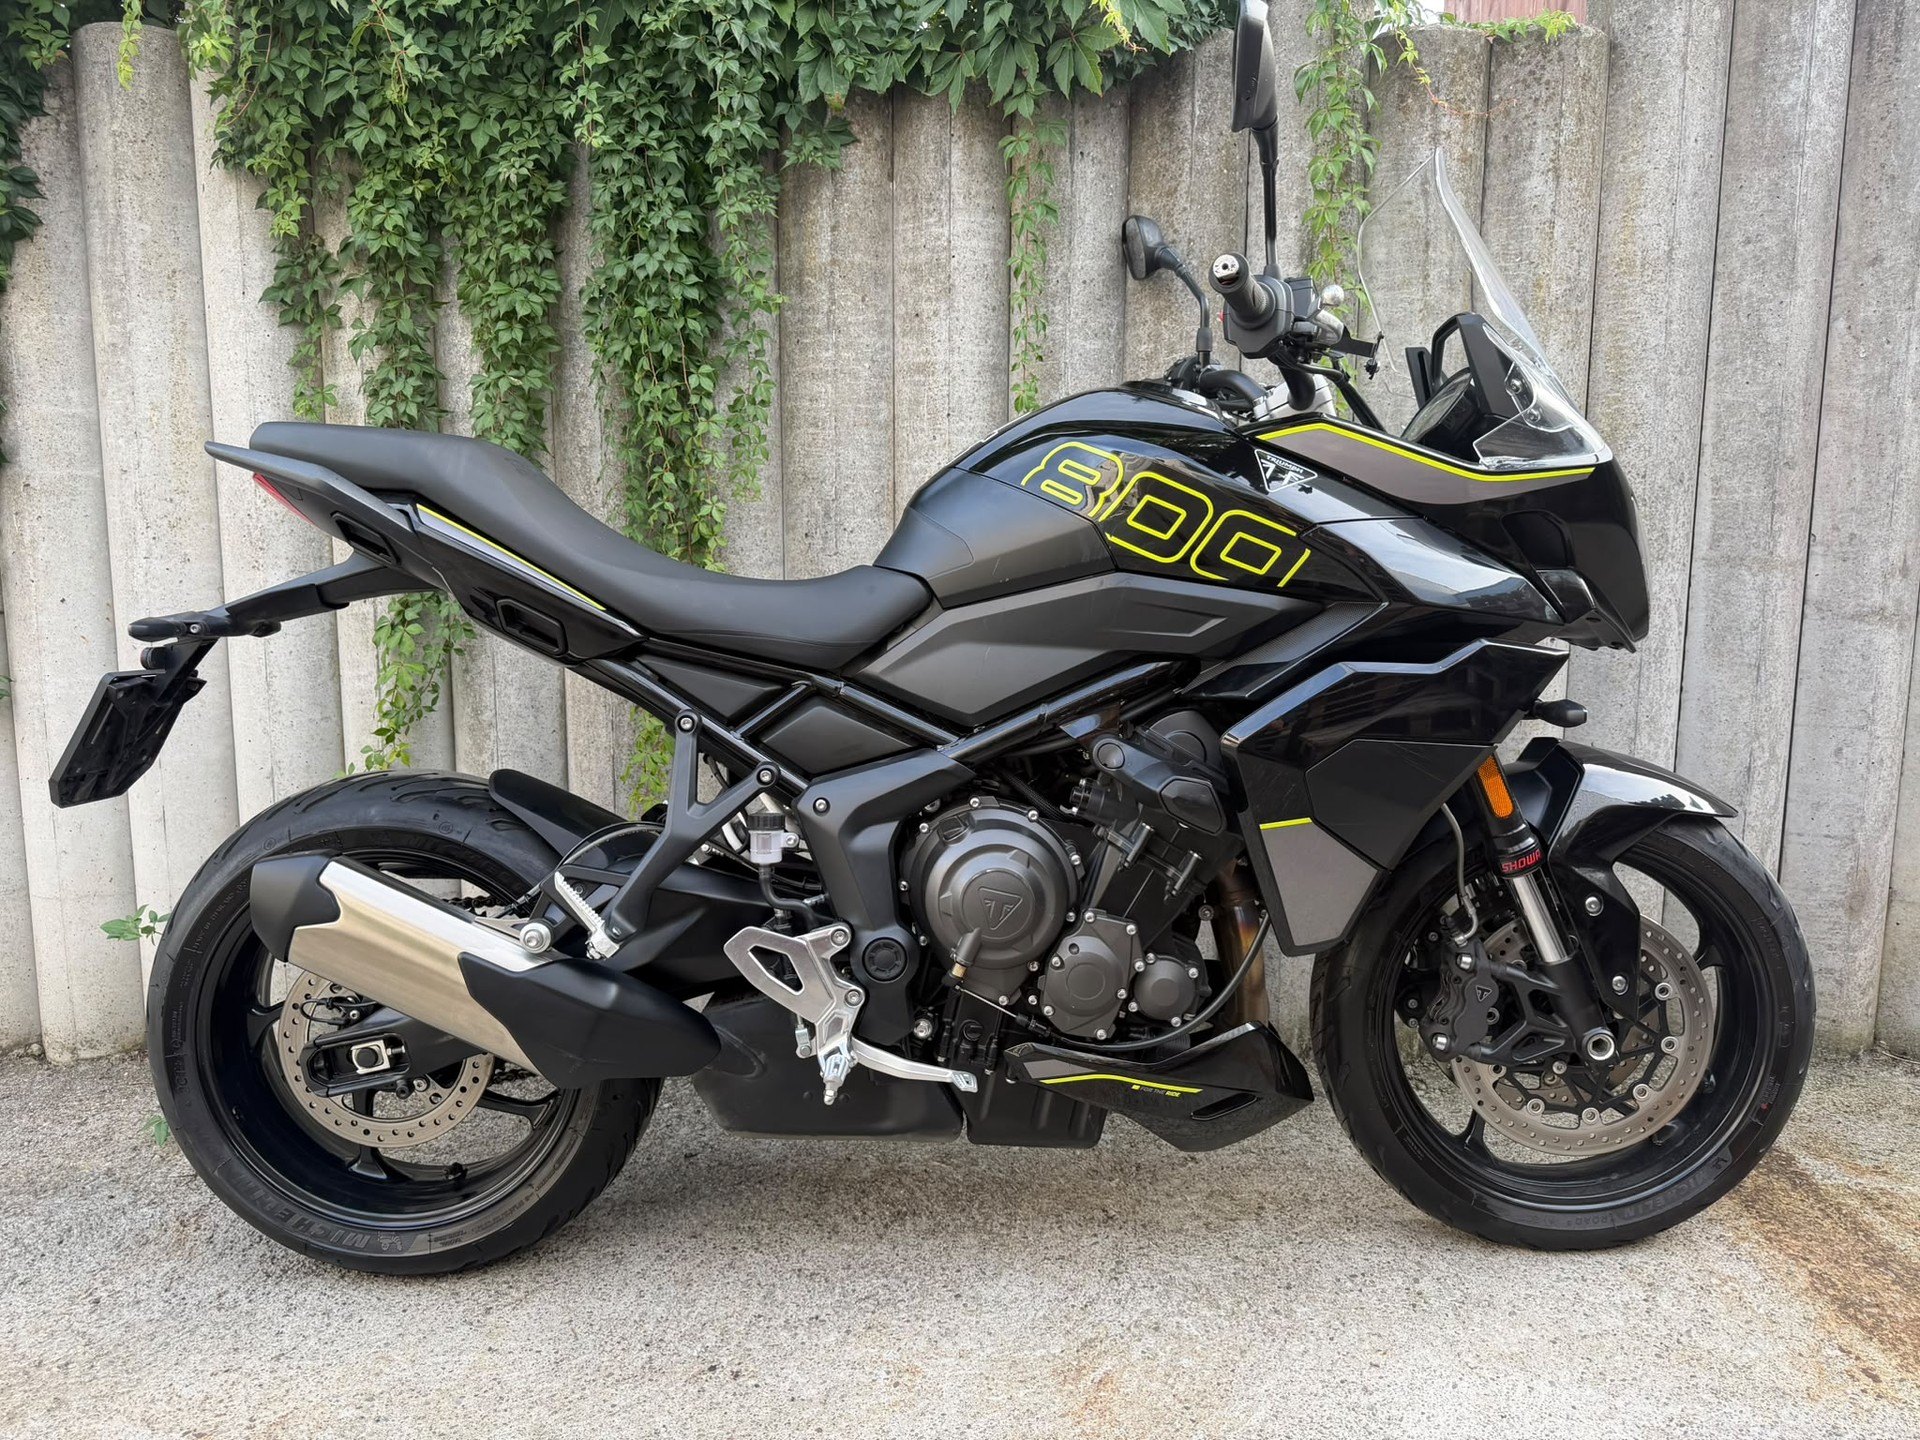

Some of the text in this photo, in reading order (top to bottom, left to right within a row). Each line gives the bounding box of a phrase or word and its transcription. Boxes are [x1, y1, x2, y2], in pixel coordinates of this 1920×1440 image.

[1266, 455, 1304, 474] TRIUMPH
[1021, 441, 1311, 588] 800
[1502, 849, 1542, 872] SHOWA
[1165, 1090, 1182, 1098] RIDE
[236, 1173, 372, 1249] MICHELIN
